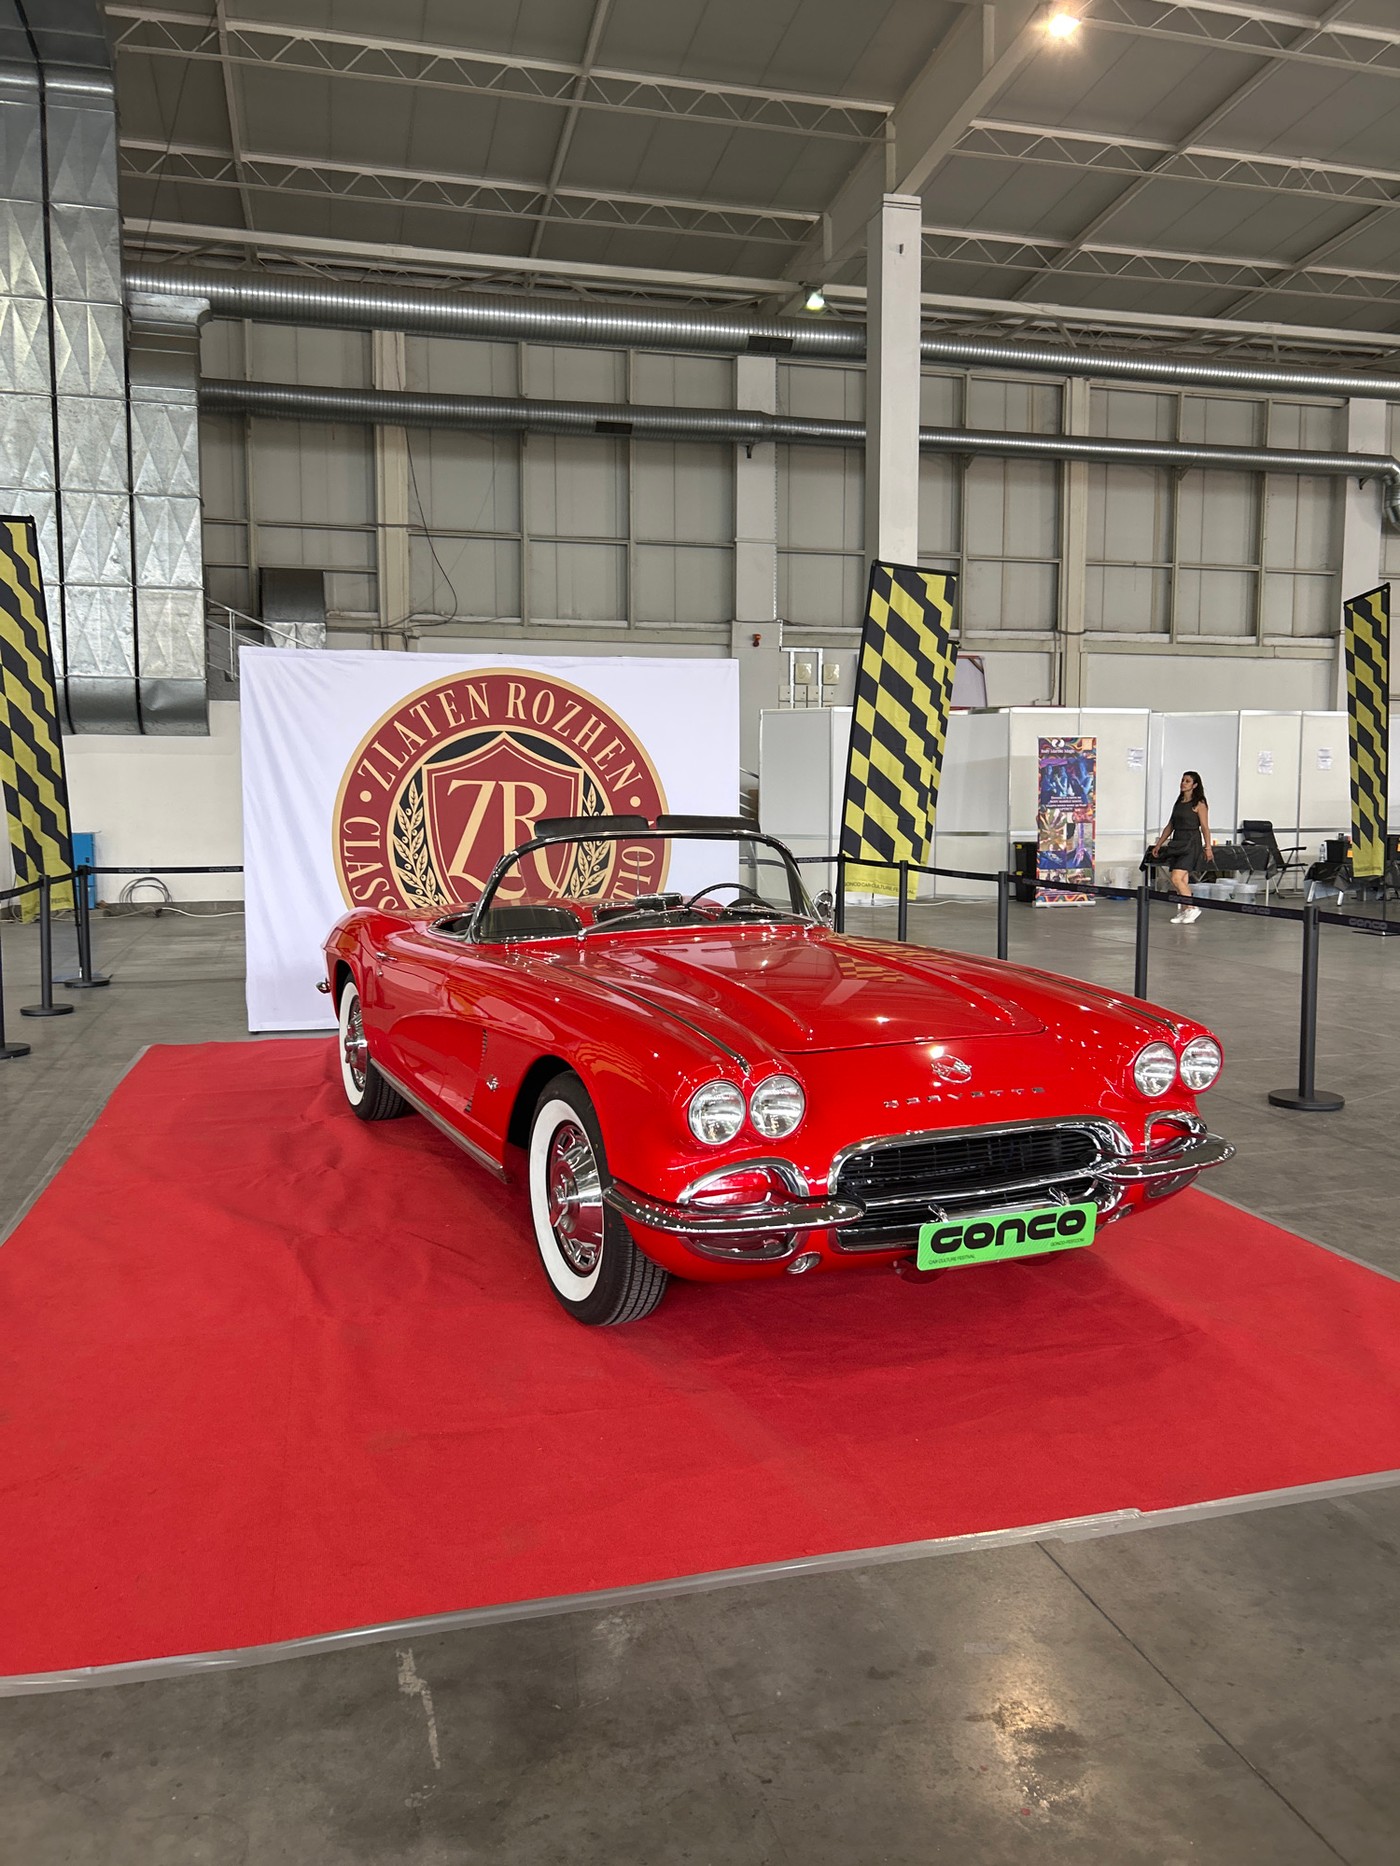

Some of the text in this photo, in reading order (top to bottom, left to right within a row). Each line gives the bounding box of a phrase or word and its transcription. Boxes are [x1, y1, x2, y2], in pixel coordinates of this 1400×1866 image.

[357, 682, 643, 793] ZLATEN ROZHEN
[447, 779, 560, 900] ZR
